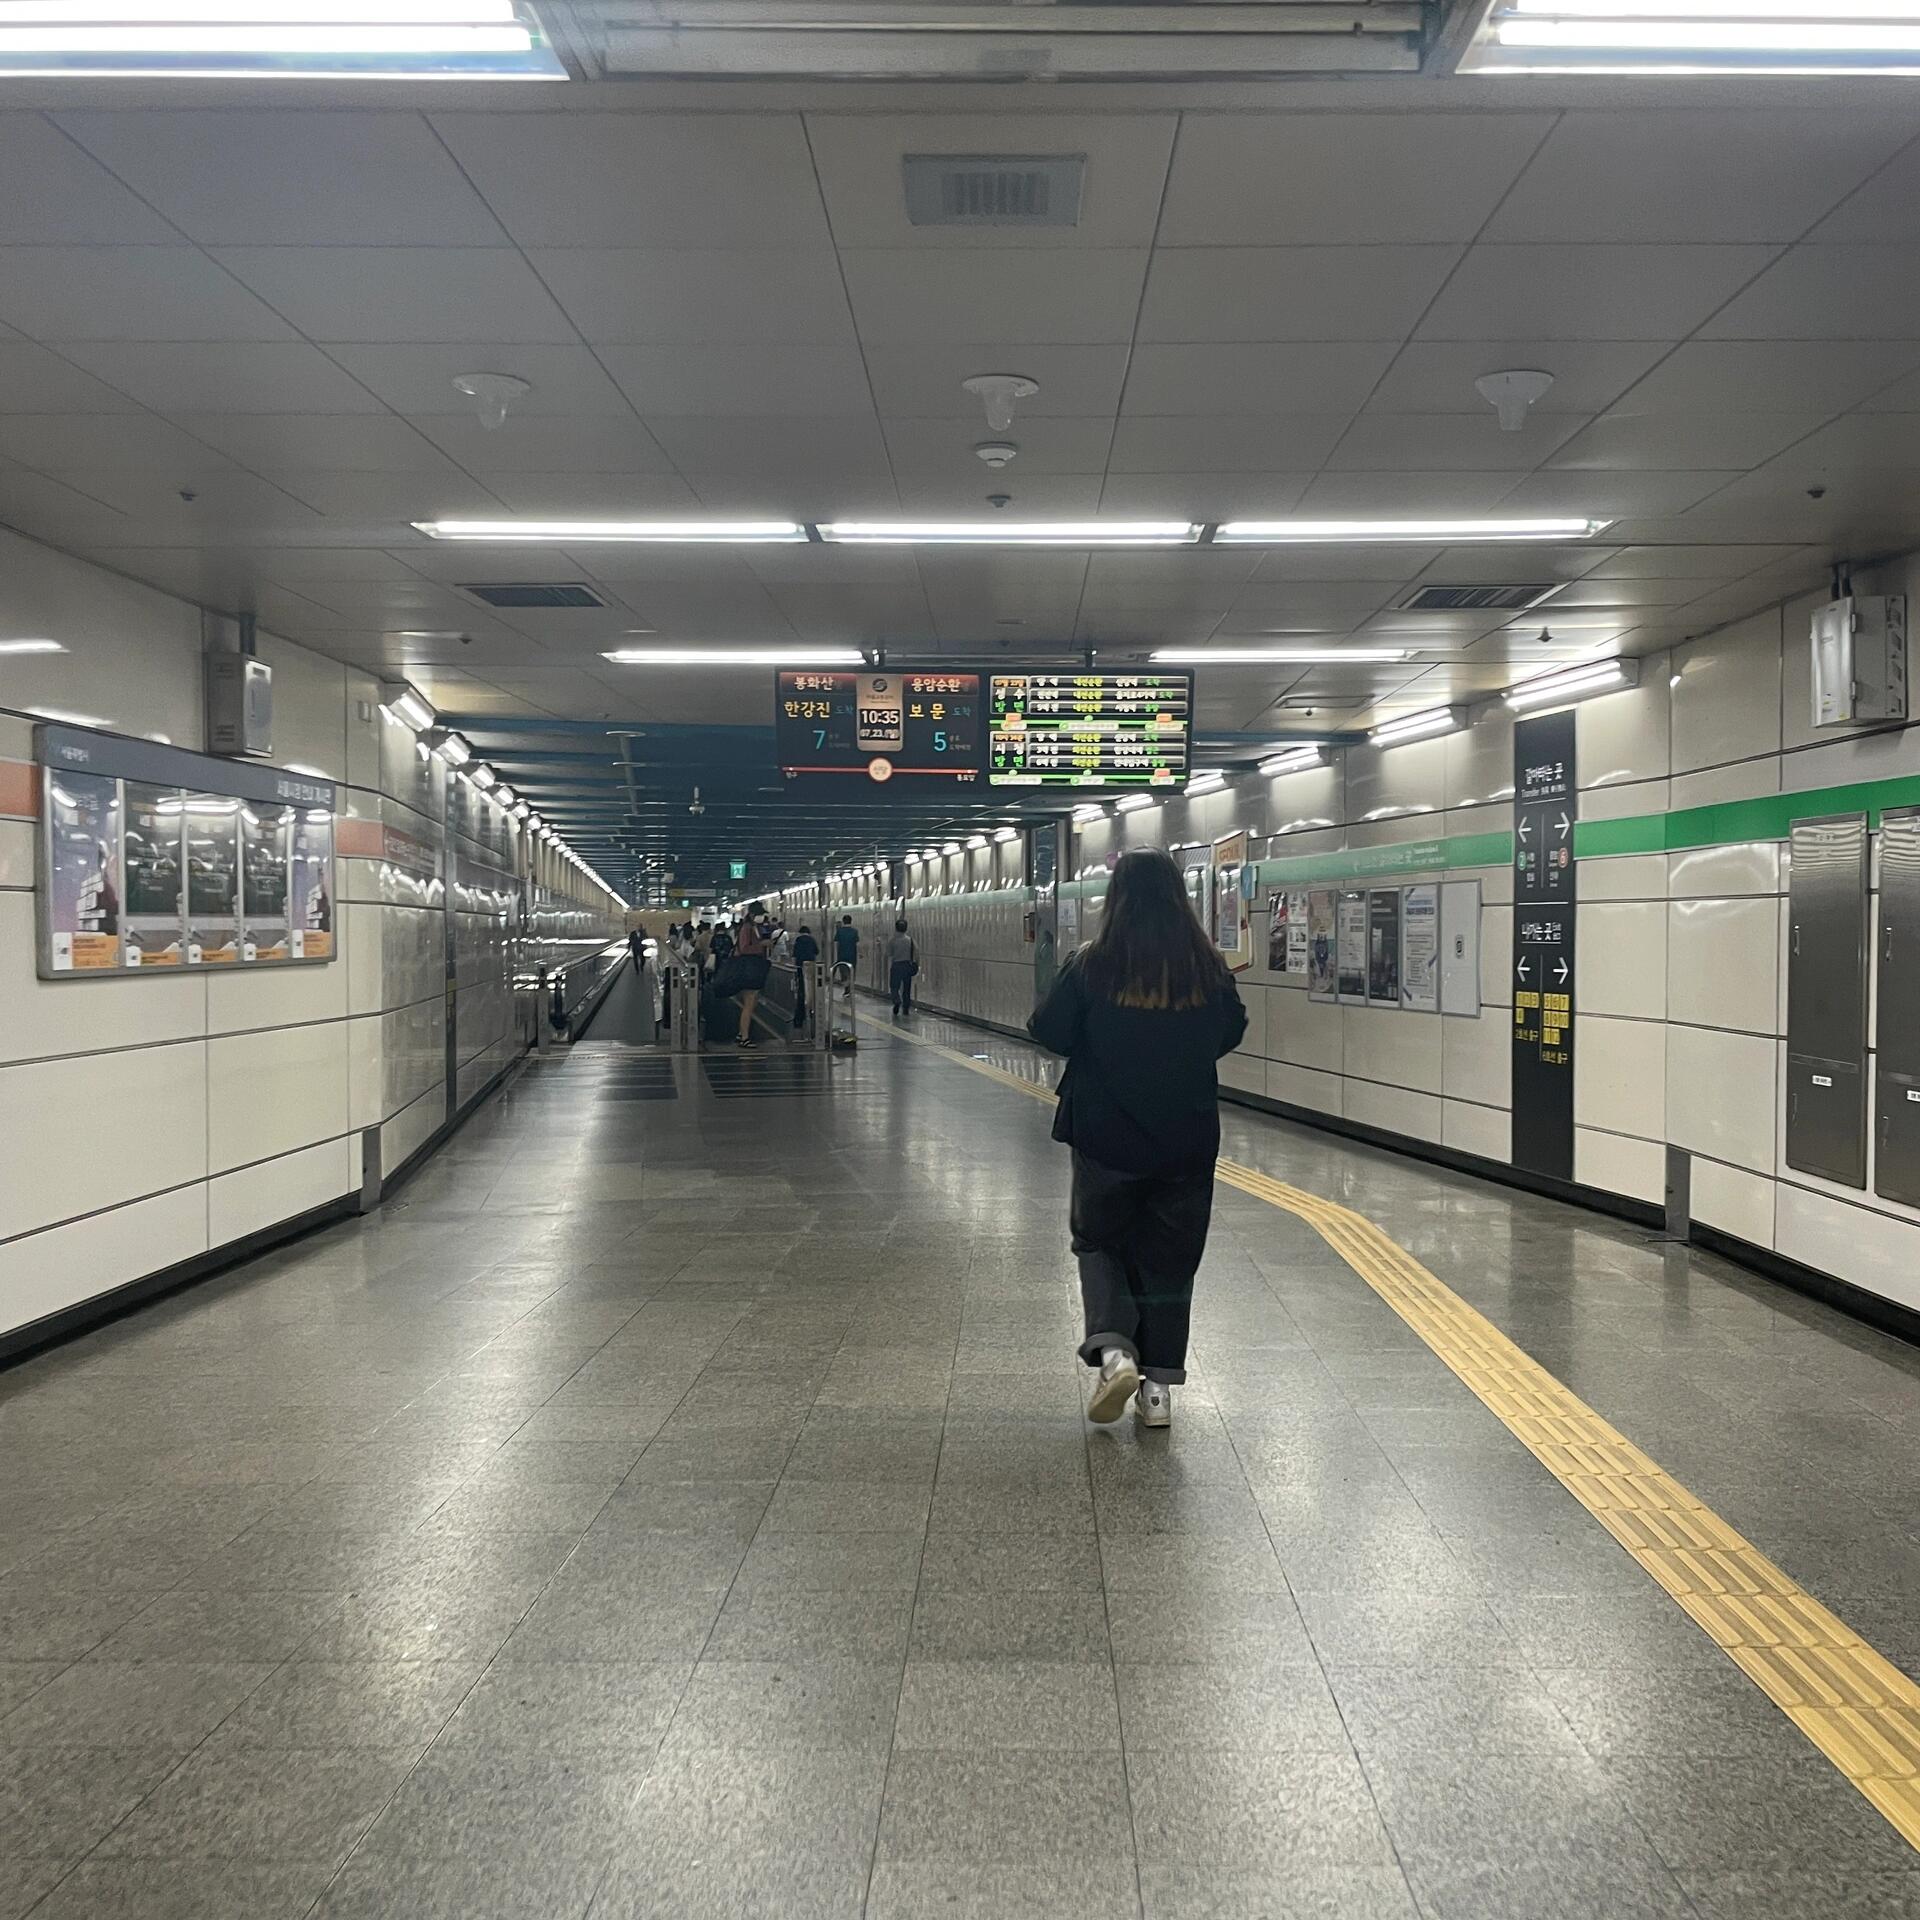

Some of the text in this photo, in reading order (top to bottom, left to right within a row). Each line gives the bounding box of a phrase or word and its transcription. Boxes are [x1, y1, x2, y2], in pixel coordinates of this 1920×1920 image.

[794, 676, 834, 691] 봉화산
[911, 677, 961, 693] 응암순환
[1144, 678, 1161, 687] 도착
[1158, 690, 1174, 700] 도착
[784, 701, 831, 718] 한강진
[861, 709, 900, 724] 10:35
[812, 729, 826, 750] 7
[933, 731, 948, 752] 5
[1142, 733, 1159, 742] 도착
[1525, 762, 1564, 785] 갈아타는 곳
[1521, 922, 1552, 941] 나가는 곳
